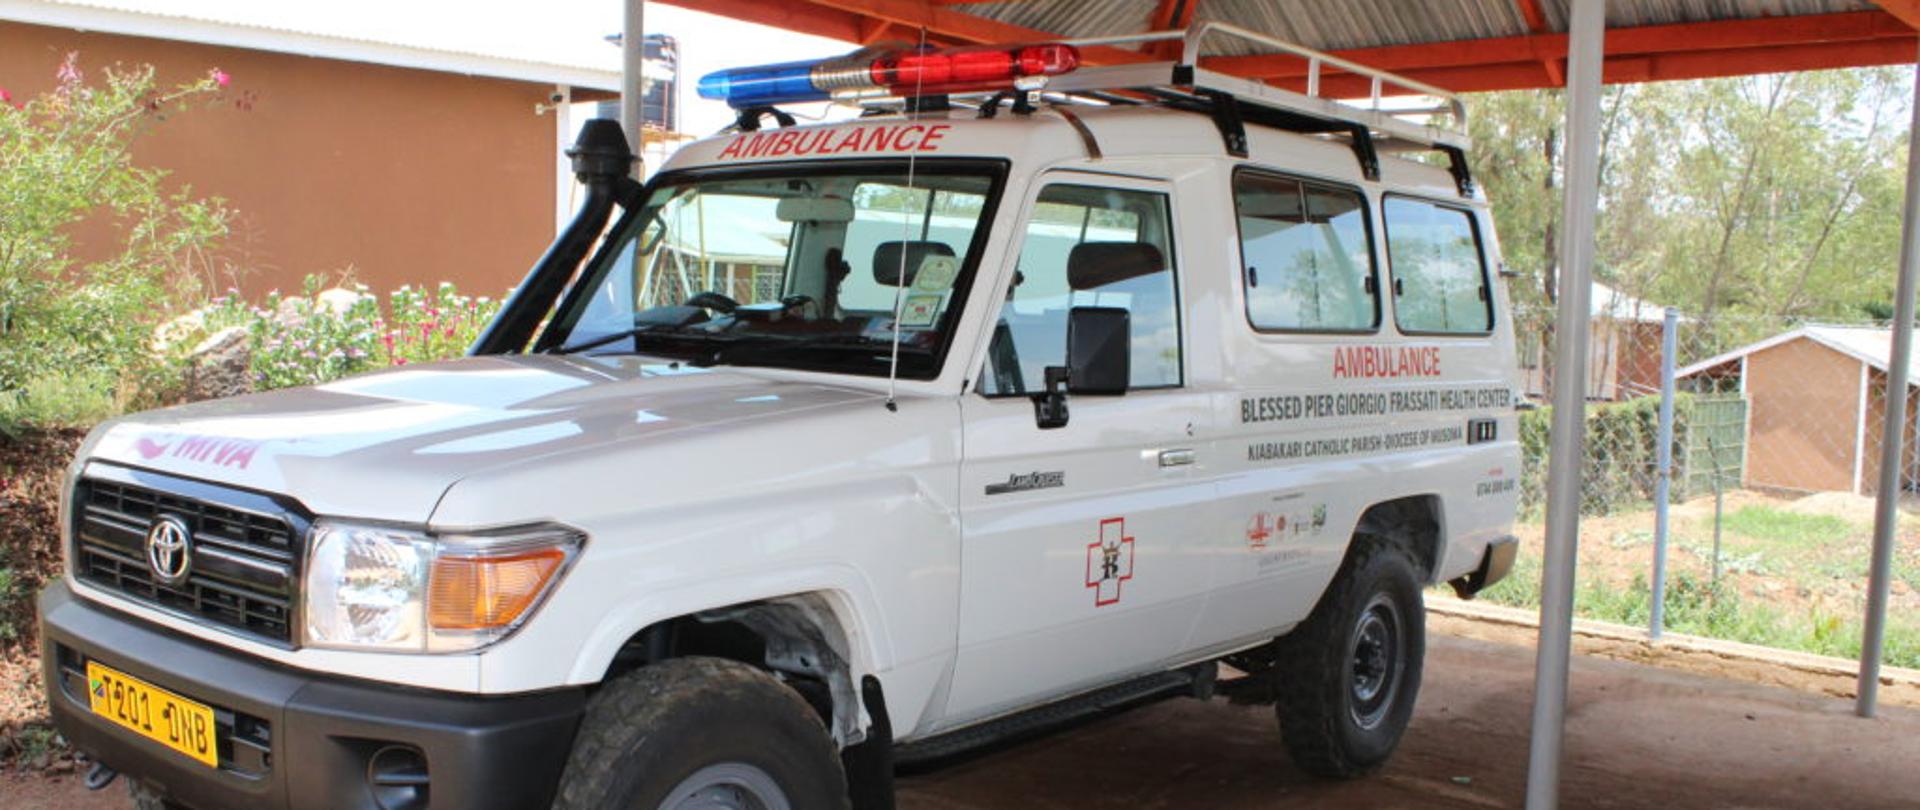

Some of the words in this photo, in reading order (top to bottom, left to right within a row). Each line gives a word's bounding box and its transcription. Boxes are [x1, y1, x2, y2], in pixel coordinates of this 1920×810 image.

[718, 125, 950, 160] AMBULANCE
[1333, 346, 1441, 378] AMBULANCE
[1241, 396, 1302, 423] BLESSED
[1305, 395, 1334, 417] PIER
[1336, 393, 1386, 416] GIORGIO
[1391, 391, 1439, 412] FRASSATI
[1441, 389, 1476, 410] HEALTH
[1477, 388, 1510, 408] CENTER
[173, 437, 259, 470] MIVA
[1304, 440, 1349, 457] CATHOLIC
[1419, 429, 1429, 446] OF
[103, 675, 152, 732] T201
[166, 702, 208, 754] DNB
